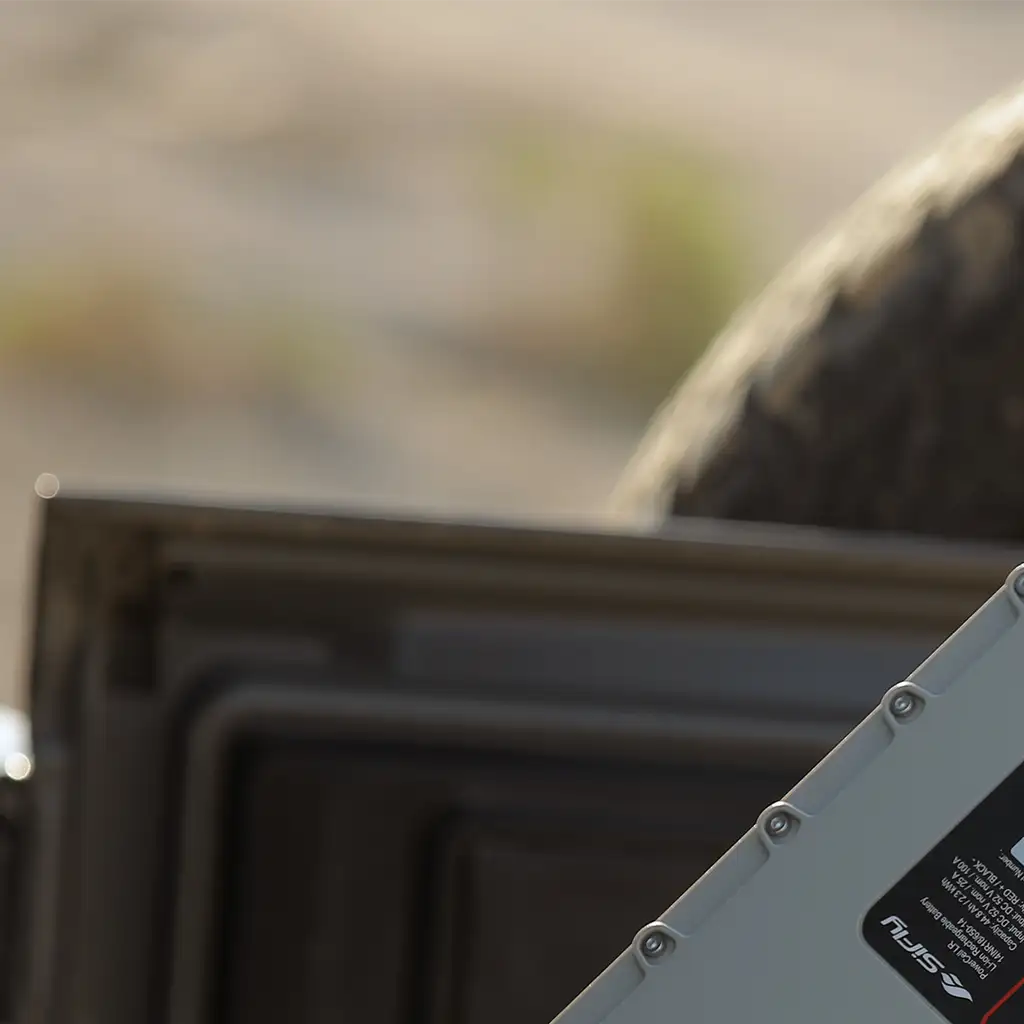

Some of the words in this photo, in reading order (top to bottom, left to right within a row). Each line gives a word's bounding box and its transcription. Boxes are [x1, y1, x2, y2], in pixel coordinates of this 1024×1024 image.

[951, 855, 962, 865] A
[956, 860, 972, 876] 100
[997, 852, 1024, 879] Number:
[950, 870, 961, 880] A
[972, 859, 999, 885] BLACK
[940, 876, 958, 895] kWh
[955, 876, 969, 889] 25
[973, 874, 991, 892] nom.
[952, 889, 968, 904] 2.3
[969, 886, 987, 905] nom.
[984, 889, 995, 899] V
[991, 893, 1004, 906] 52
[1002, 887, 1021, 906] RED
[919, 896, 944, 921] Battery
[967, 901, 980, 914] Ah
[981, 901, 991, 911] V
[987, 905, 1001, 919] 52
[999, 901, 1015, 916] DC
[974, 909, 992, 926] 44.8
[995, 914, 1011, 929] DC
[879, 914, 946, 974] SiFly
[939, 915, 982, 958] Rechargeable
[988, 921, 1018, 952] Capacity:
[946, 939, 961, 954] LR
[955, 948, 990, 981] PowerCell
